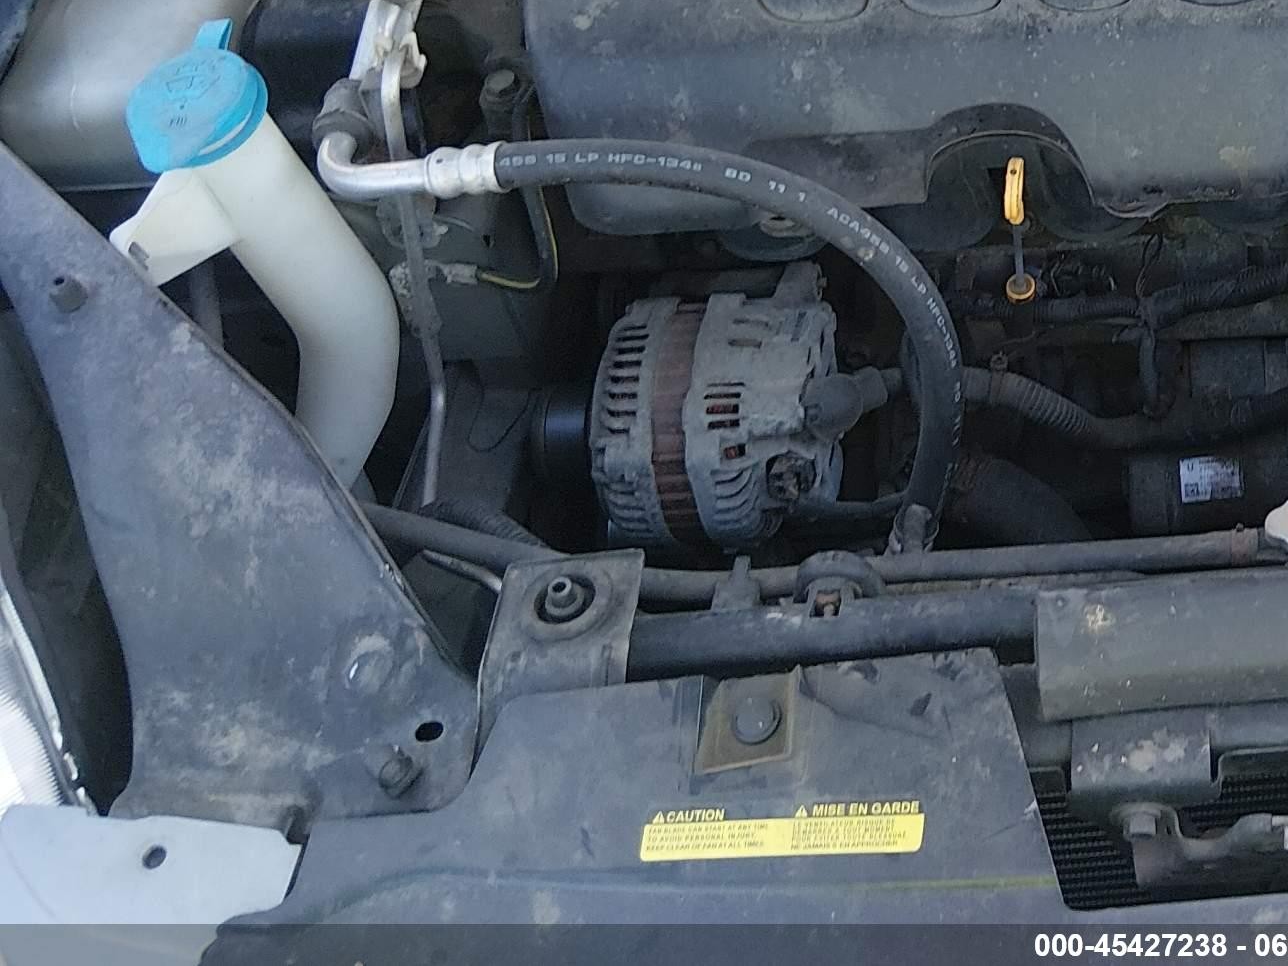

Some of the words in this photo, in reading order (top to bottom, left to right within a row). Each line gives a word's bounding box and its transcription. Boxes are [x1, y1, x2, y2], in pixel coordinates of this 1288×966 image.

[574, 151, 599, 163] LP
[666, 808, 725, 822] CAUTION
[812, 802, 845, 817] MISE
[849, 801, 868, 815] EN
[871, 800, 920, 814] GARDE
